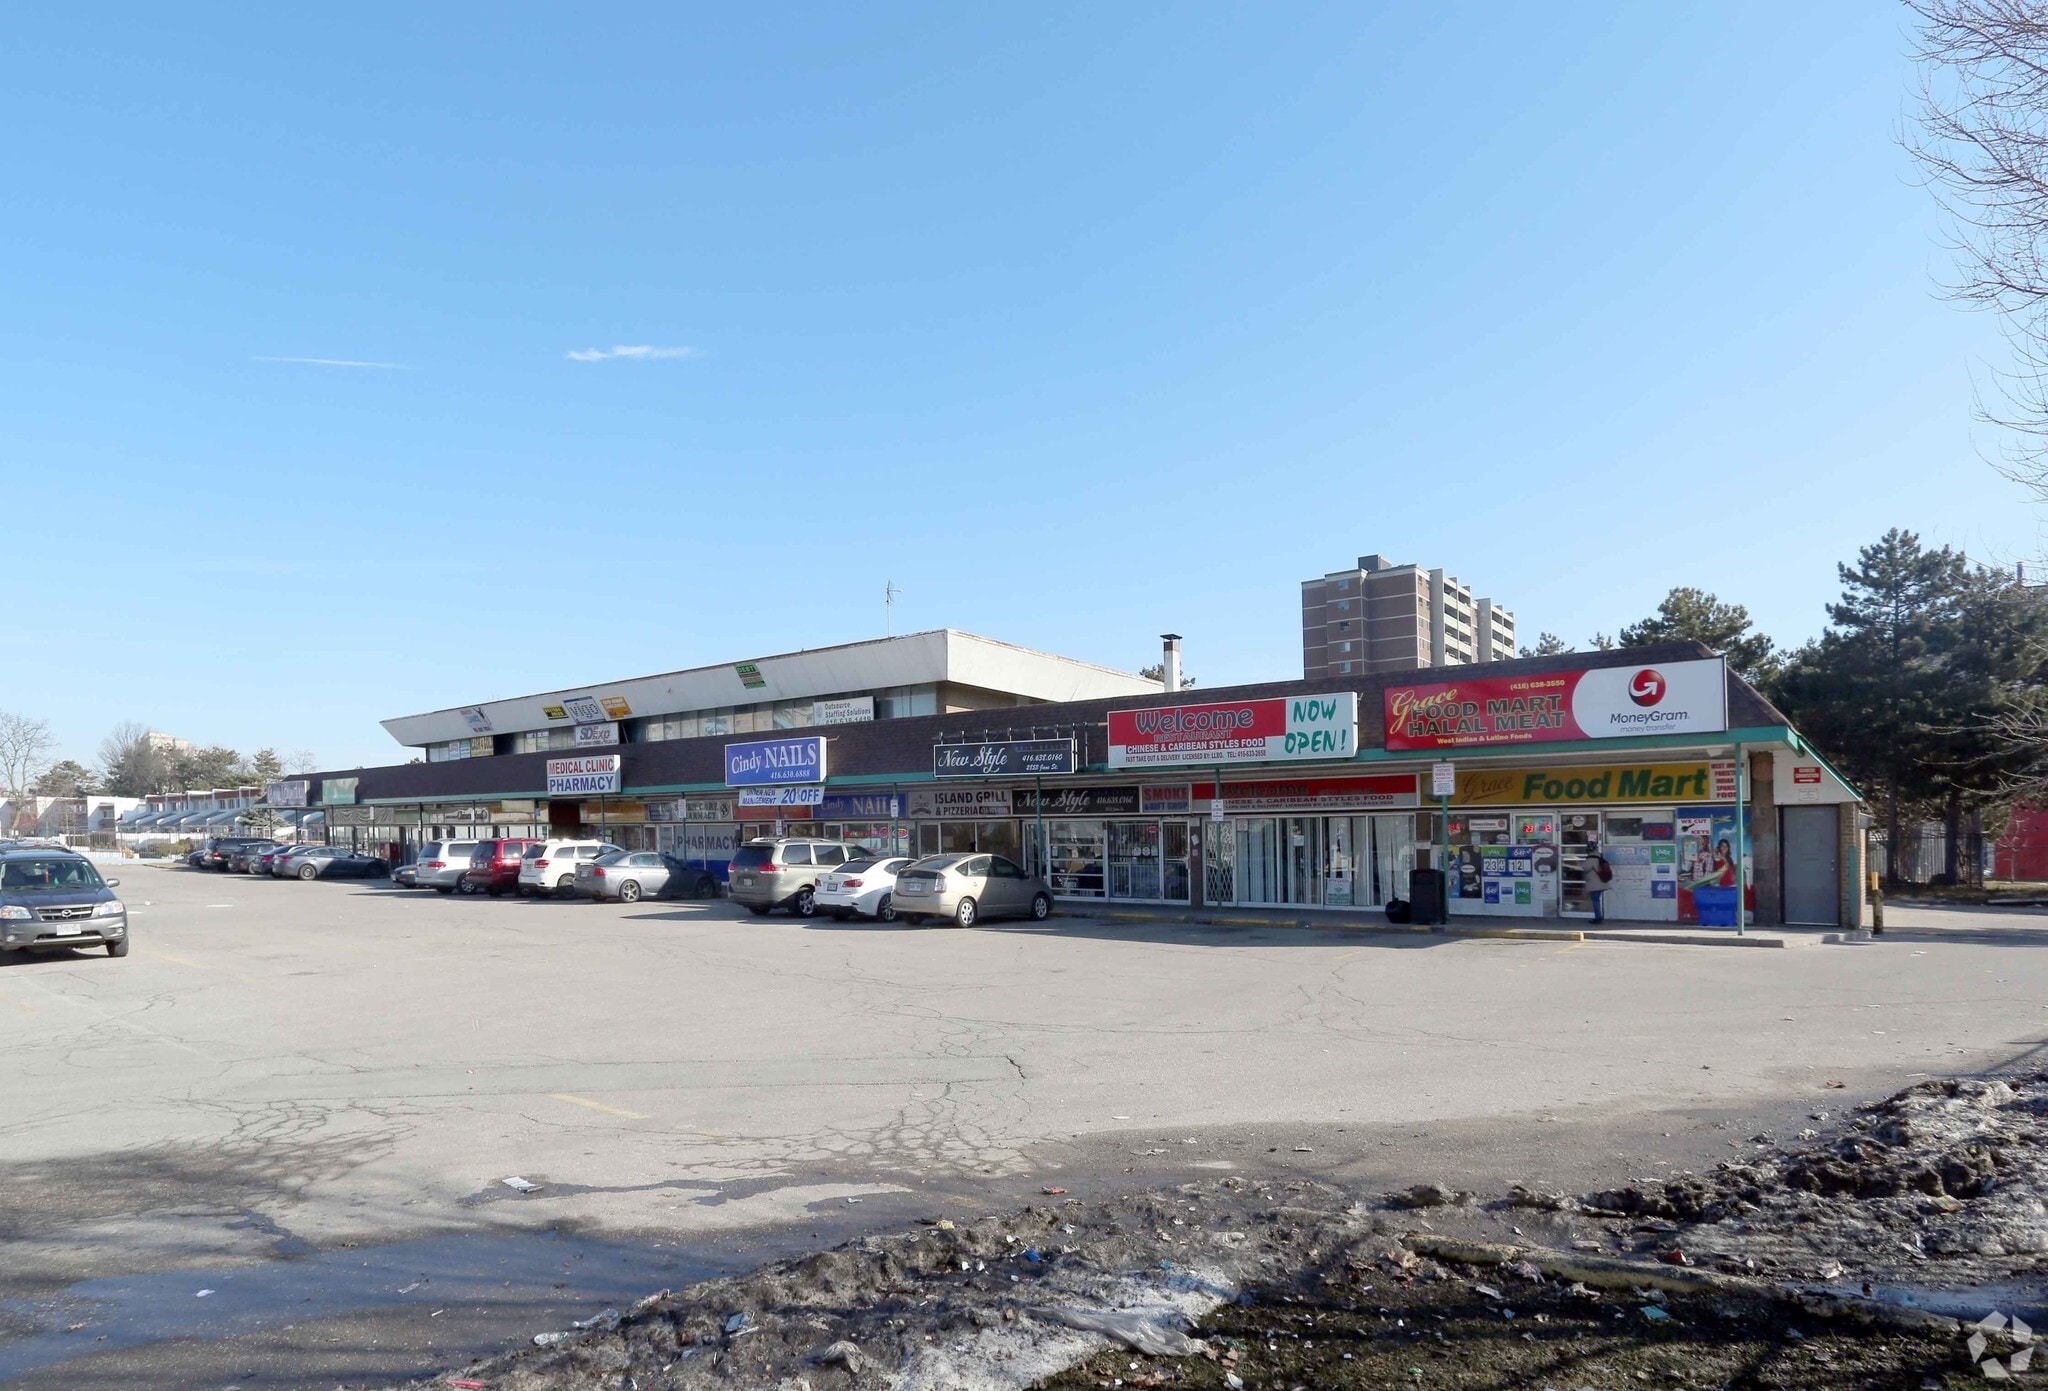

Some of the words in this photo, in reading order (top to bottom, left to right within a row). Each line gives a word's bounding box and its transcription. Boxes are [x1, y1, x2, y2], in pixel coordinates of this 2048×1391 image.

[824, 702, 850, 710] Outsource
[825, 710, 846, 718] Staffing
[846, 708, 871, 716] Solutions
[1292, 699, 1337, 723] NOW
[1389, 689, 1458, 735] Grace
[1411, 702, 1479, 721] FOOD
[1487, 694, 1562, 716] MART
[1135, 709, 1254, 735] Welcome
[1407, 714, 1488, 737] HALAL
[1495, 711, 1566, 732] MEAT
[1610, 711, 1688, 725] MoneyGram
[1646, 723, 1677, 731] transfer
[1154, 729, 1232, 743] RESTAURANT
[1455, 735, 1478, 743] Indian
[1486, 732, 1509, 741] Latino
[1510, 731, 1533, 740] Foods
[1127, 744, 1159, 754] CHINESE
[1160, 743, 1167, 751] &
[1168, 740, 1206, 750] CARIBEAN
[1208, 739, 1239, 749] STYLES
[1241, 737, 1264, 747] FOOD
[548, 763, 584, 775] MEDICAL
[585, 758, 614, 772] CLINIC
[731, 751, 762, 774] Cindy
[764, 743, 817, 769] NAILS
[938, 750, 969, 767] New
[970, 746, 1008, 774] Style
[550, 776, 613, 792] PHARMACY
[1461, 773, 1514, 804] Grace
[1522, 773, 1613, 800] Food
[1617, 768, 1708, 798] Mart
[935, 792, 973, 804] ISLAND
[976, 791, 1007, 802] GRILL
[1051, 789, 1091, 813] Style
[1144, 788, 1188, 800] SMOKE
[852, 797, 891, 815] NAIL
[935, 808, 941, 816] &
[943, 806, 979, 816] PIZZERIA
[677, 836, 737, 849] PHARMACY
